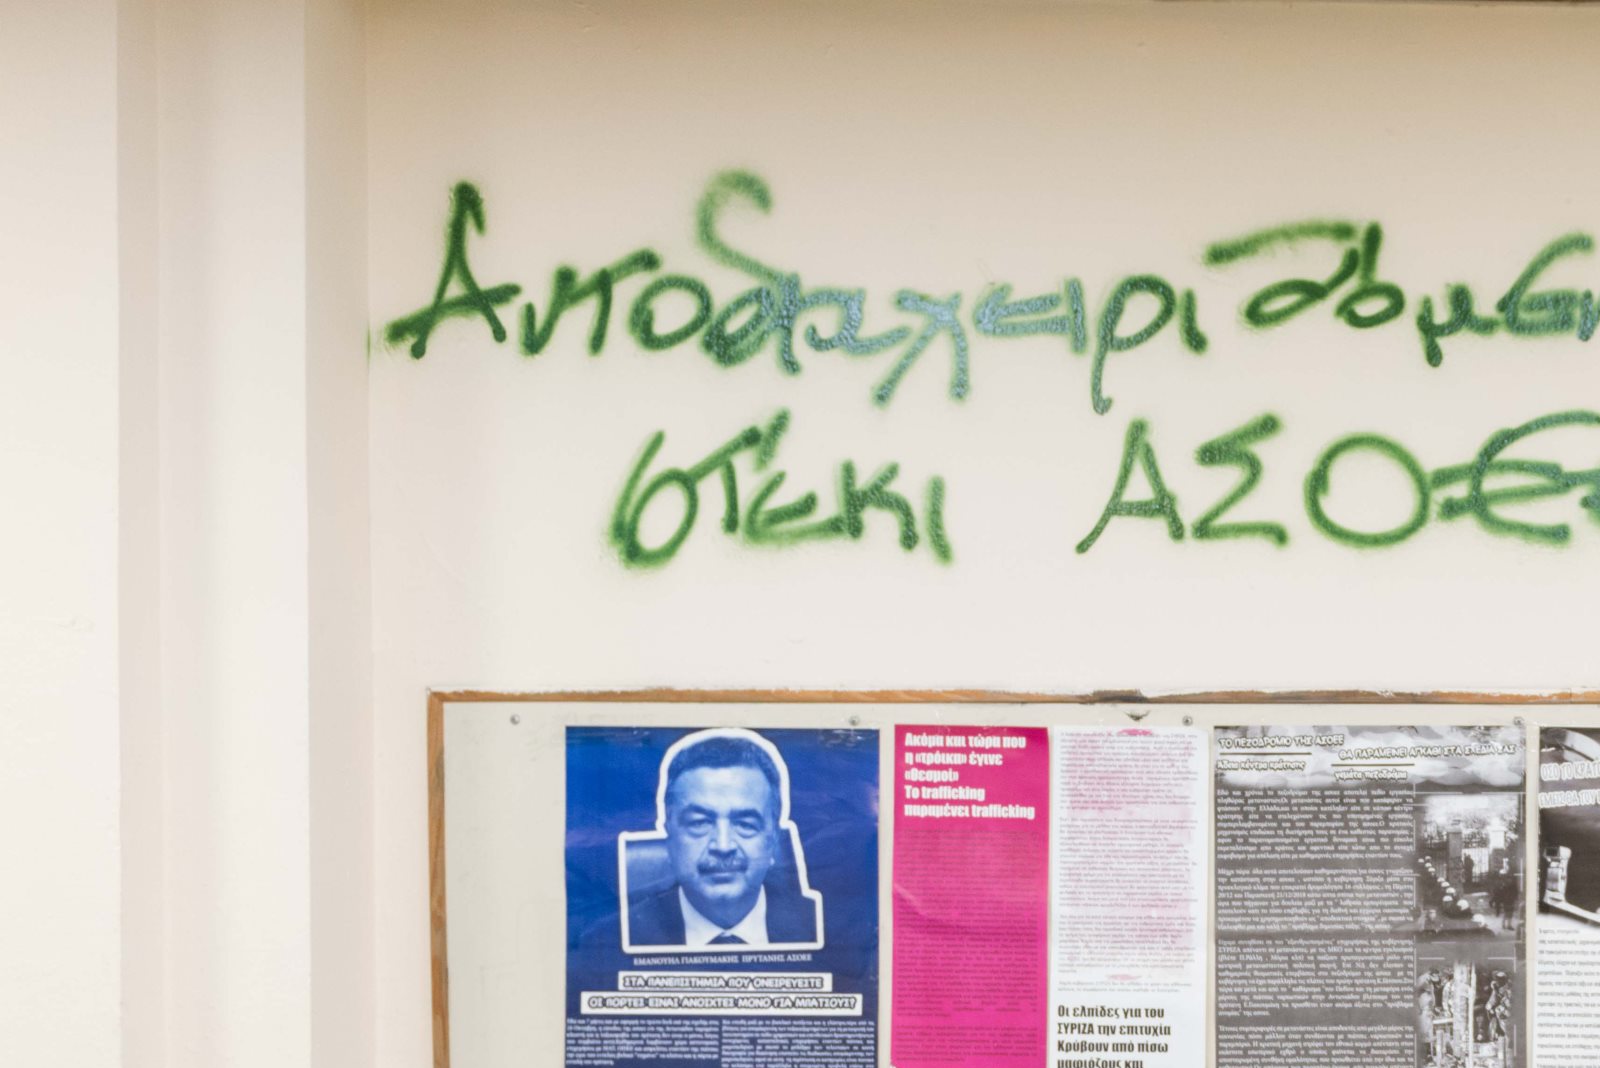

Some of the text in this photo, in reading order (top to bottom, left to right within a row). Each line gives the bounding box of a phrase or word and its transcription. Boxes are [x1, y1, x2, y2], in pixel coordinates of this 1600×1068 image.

[946, 735, 966, 747] και
[968, 733, 1001, 749] τώρα
[1002, 736, 1026, 748] που
[921, 786, 985, 801] trafficking
[904, 803, 1035, 820] παραμένει trafficking
[1058, 1005, 1165, 1019] Οι ελπίδες για του
[1057, 1023, 1171, 1037] ΣΥΡΙΖΑ την επιτυχία
[1057, 1040, 1169, 1053] Κρύβουν από πίσω
